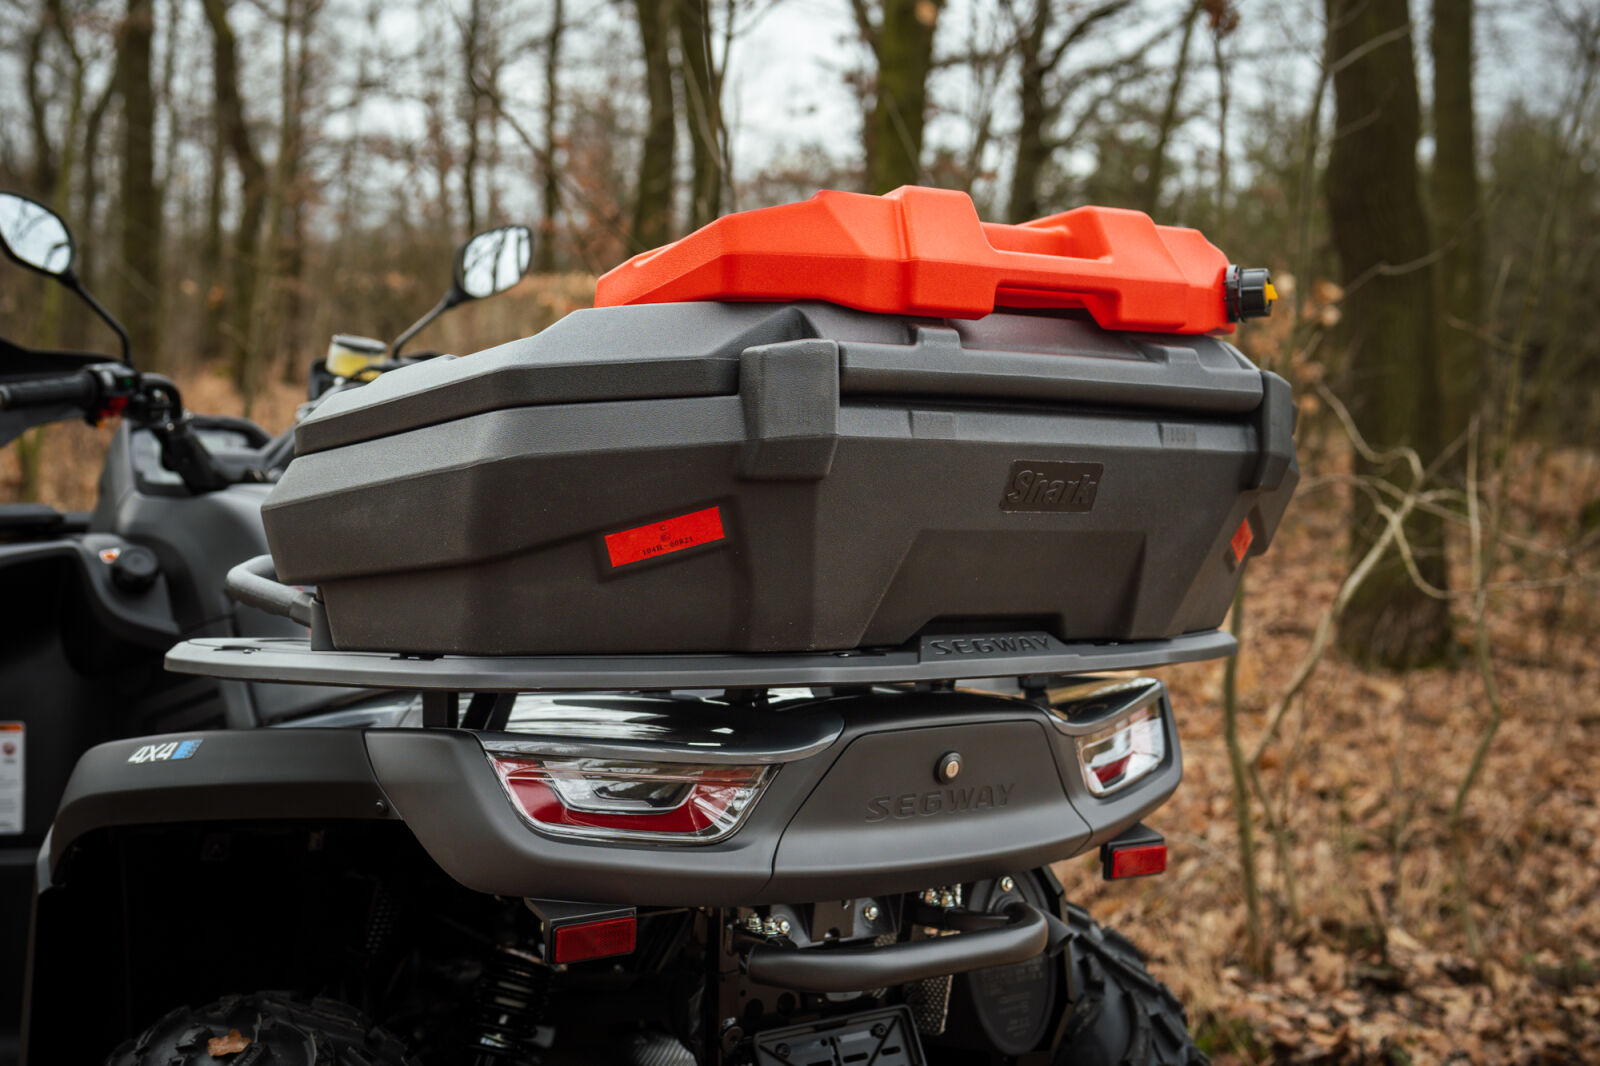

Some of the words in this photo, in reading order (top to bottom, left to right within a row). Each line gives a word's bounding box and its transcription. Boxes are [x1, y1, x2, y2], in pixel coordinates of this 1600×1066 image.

[1006, 469, 1097, 504] Shark
[929, 635, 1050, 655] SEGWAY
[864, 782, 1016, 823] SEGWAY
